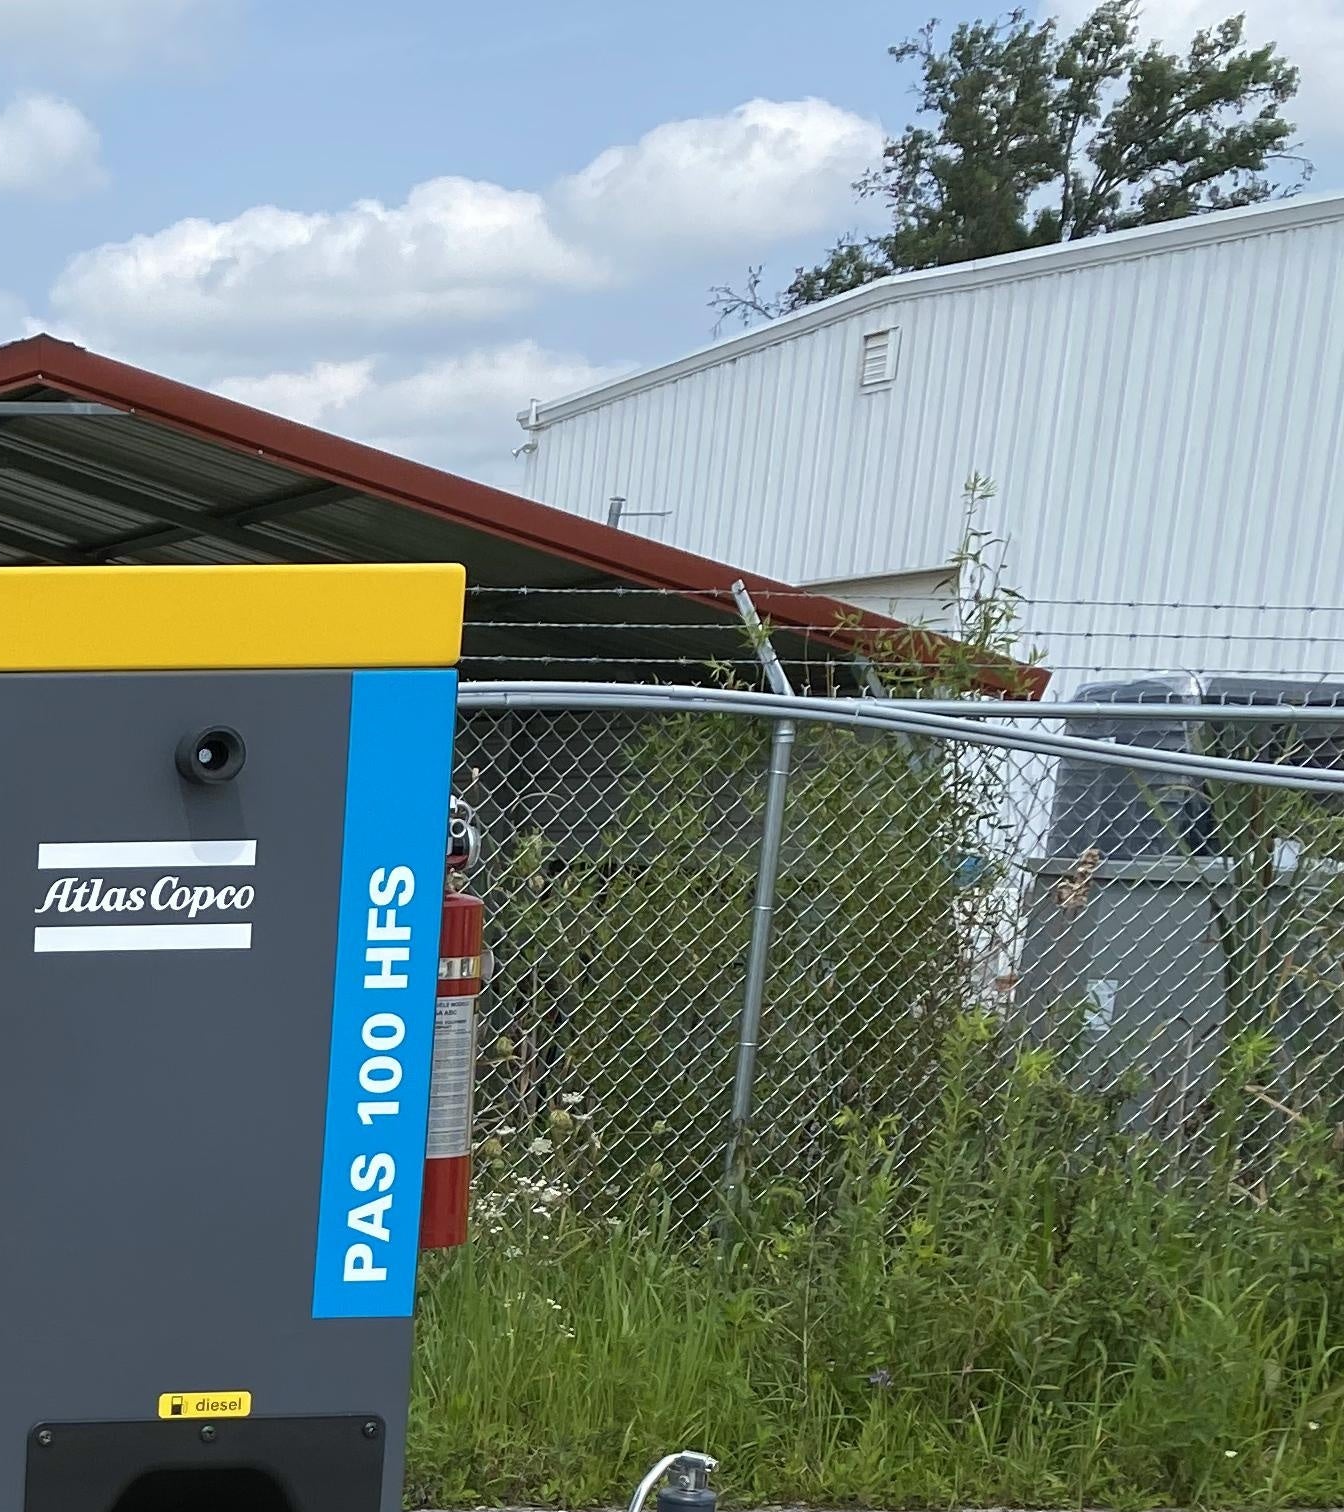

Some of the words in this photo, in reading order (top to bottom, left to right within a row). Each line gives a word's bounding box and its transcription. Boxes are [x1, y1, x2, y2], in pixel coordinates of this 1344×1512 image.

[34, 876, 147, 914] Atlas
[150, 875, 255, 918] Copco
[362, 864, 417, 991] HFS
[356, 1011, 407, 1128] 100
[342, 1150, 397, 1284] PAS
[195, 1397, 243, 1412] diesel
